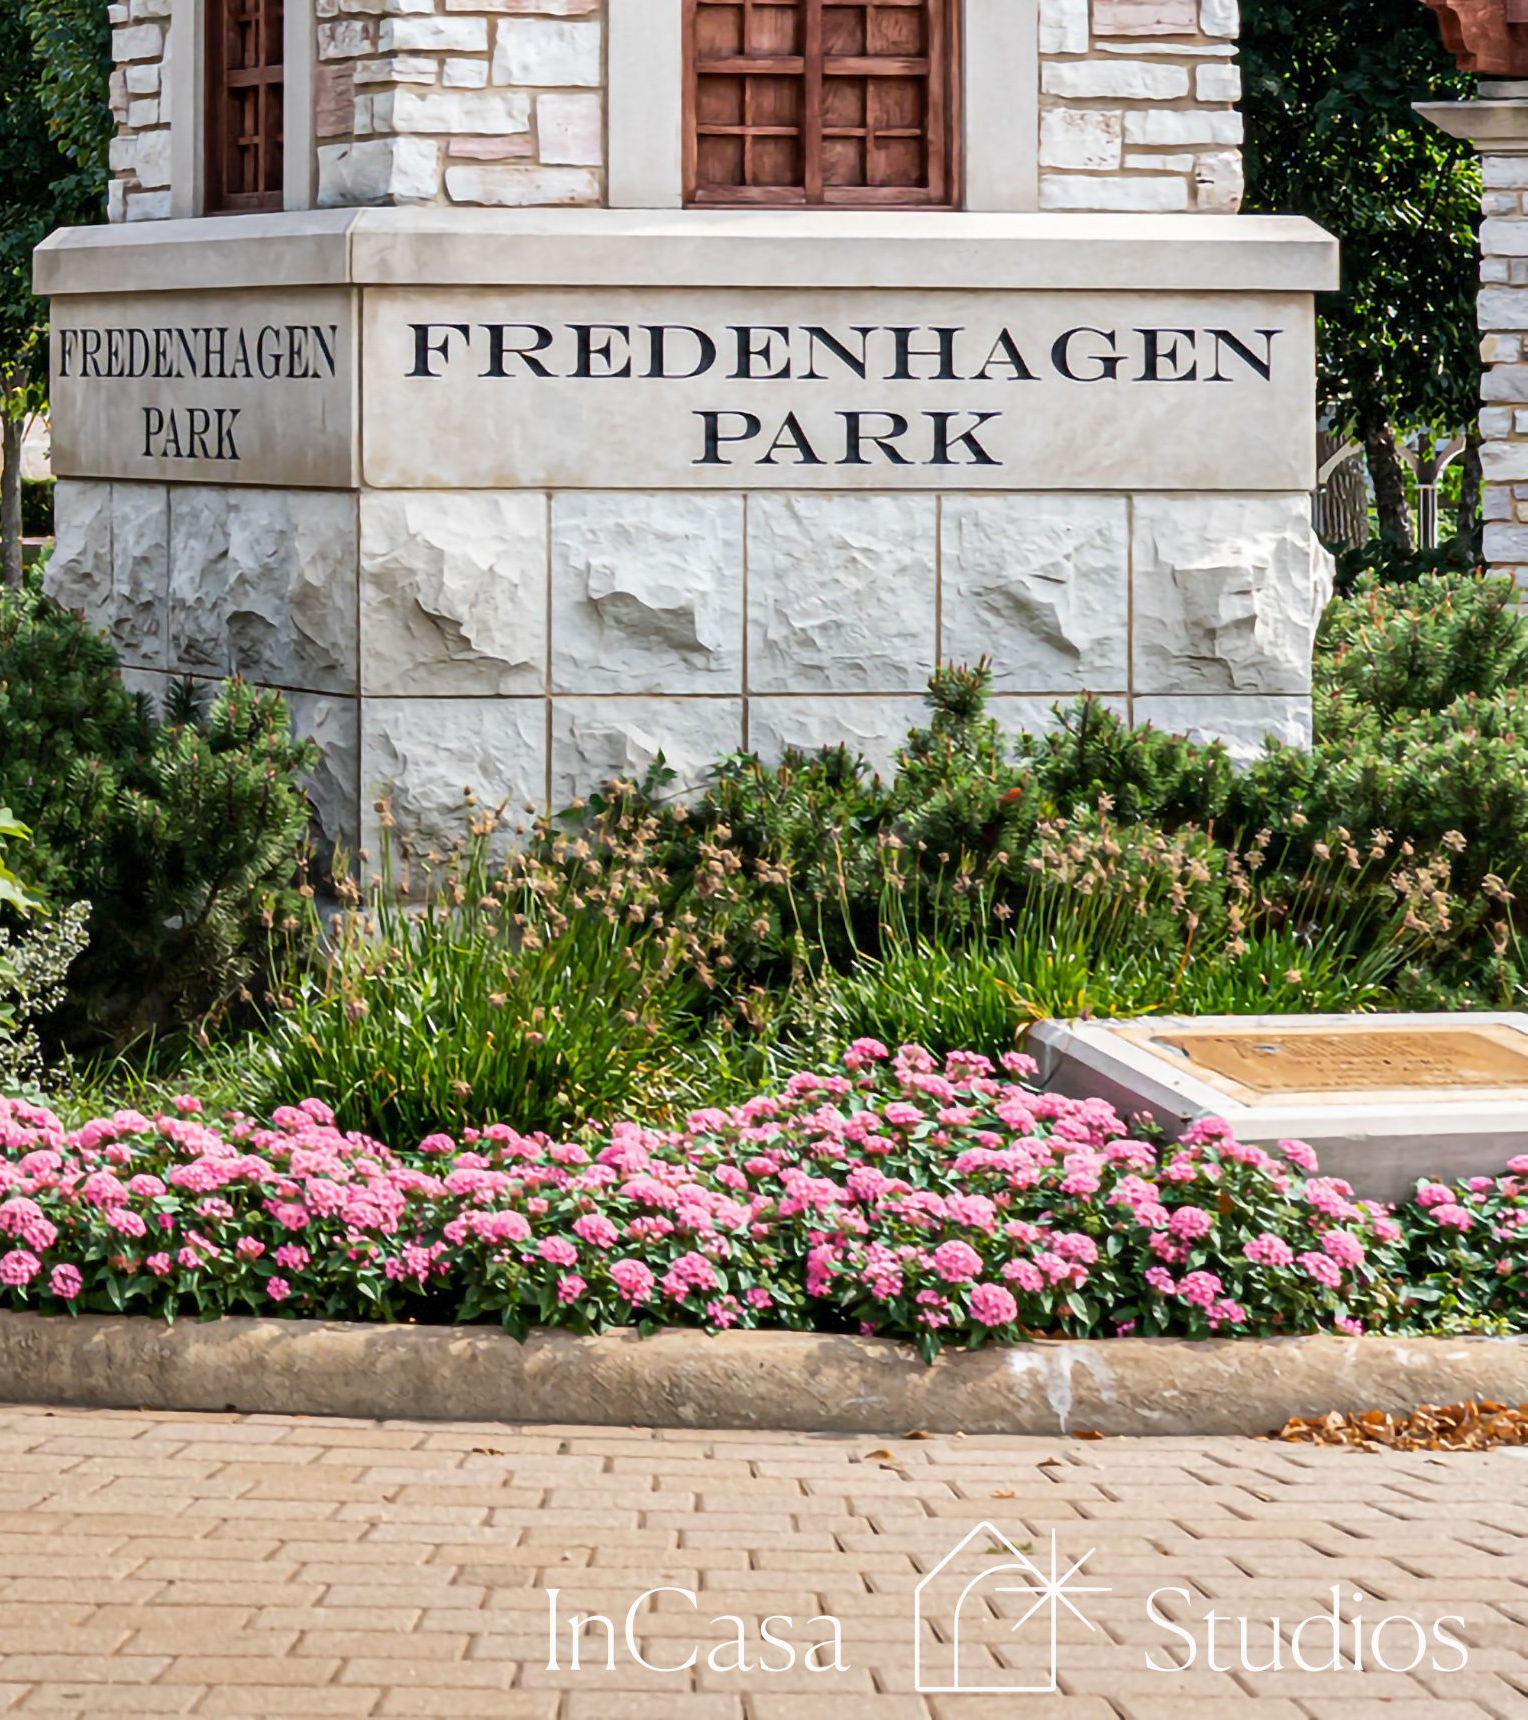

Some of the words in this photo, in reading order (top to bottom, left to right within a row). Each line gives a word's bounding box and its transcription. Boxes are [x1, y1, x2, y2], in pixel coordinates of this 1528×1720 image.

[57, 323, 338, 380] FREDENHAGEN
[403, 323, 1283, 382] FREDENHAGEN
[141, 406, 241, 460] PARK
[691, 410, 1004, 467] PARK
